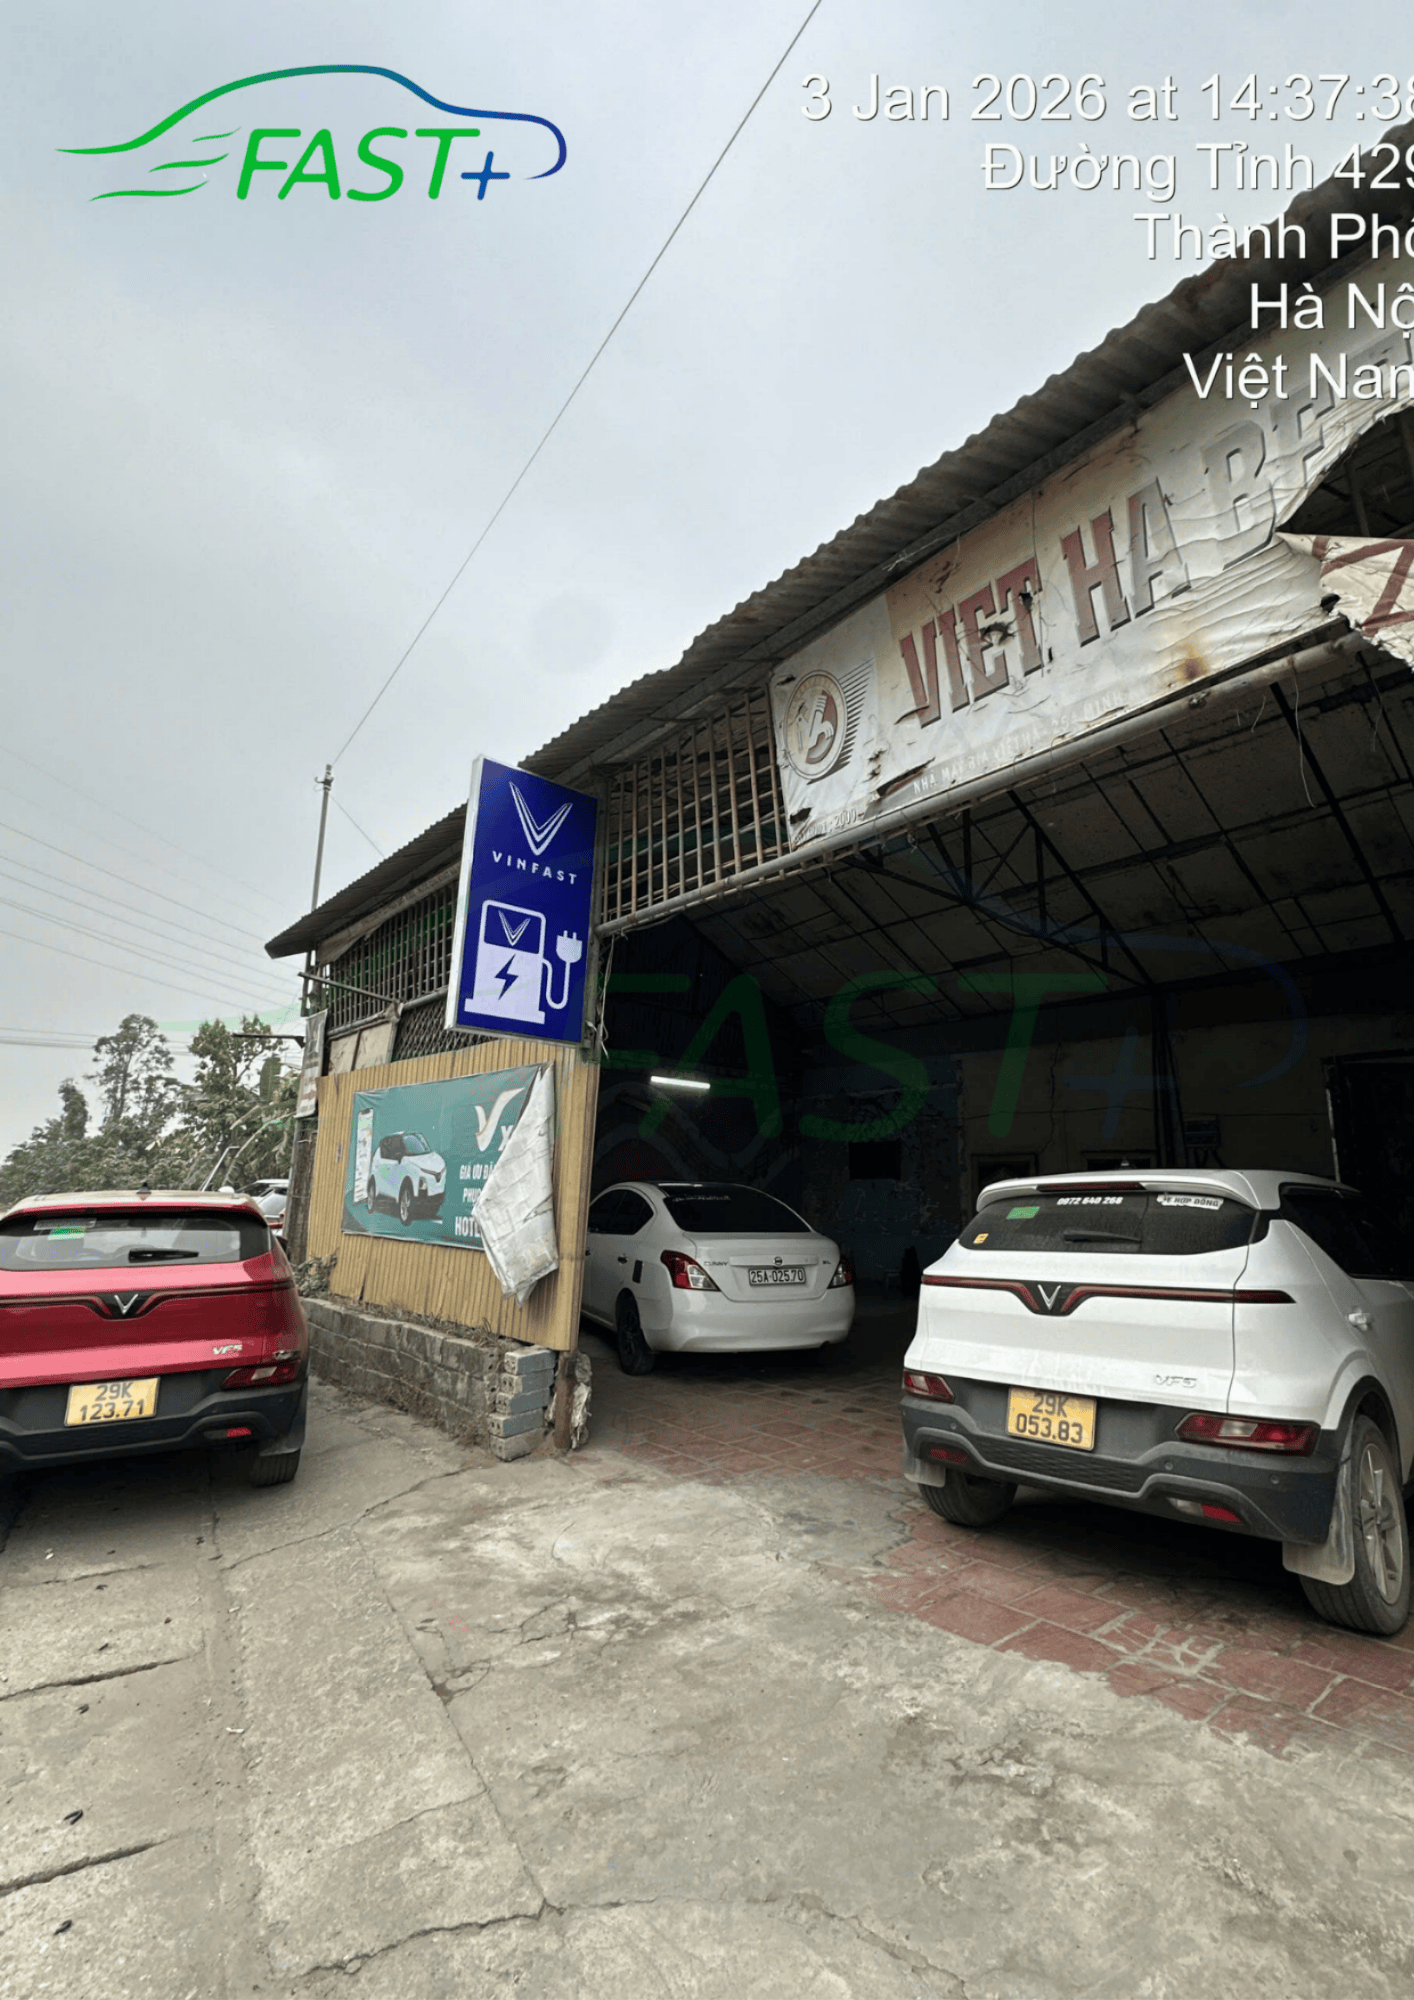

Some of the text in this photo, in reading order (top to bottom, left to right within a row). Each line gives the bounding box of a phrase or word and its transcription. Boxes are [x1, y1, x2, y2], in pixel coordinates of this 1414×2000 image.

[492, 850, 577, 885] VINFAST
[94, 1382, 133, 1401] 29K
[1031, 1391, 1069, 1418] 29K
[79, 1398, 146, 1422] 123.71
[1015, 1412, 1085, 1445] 053.83
